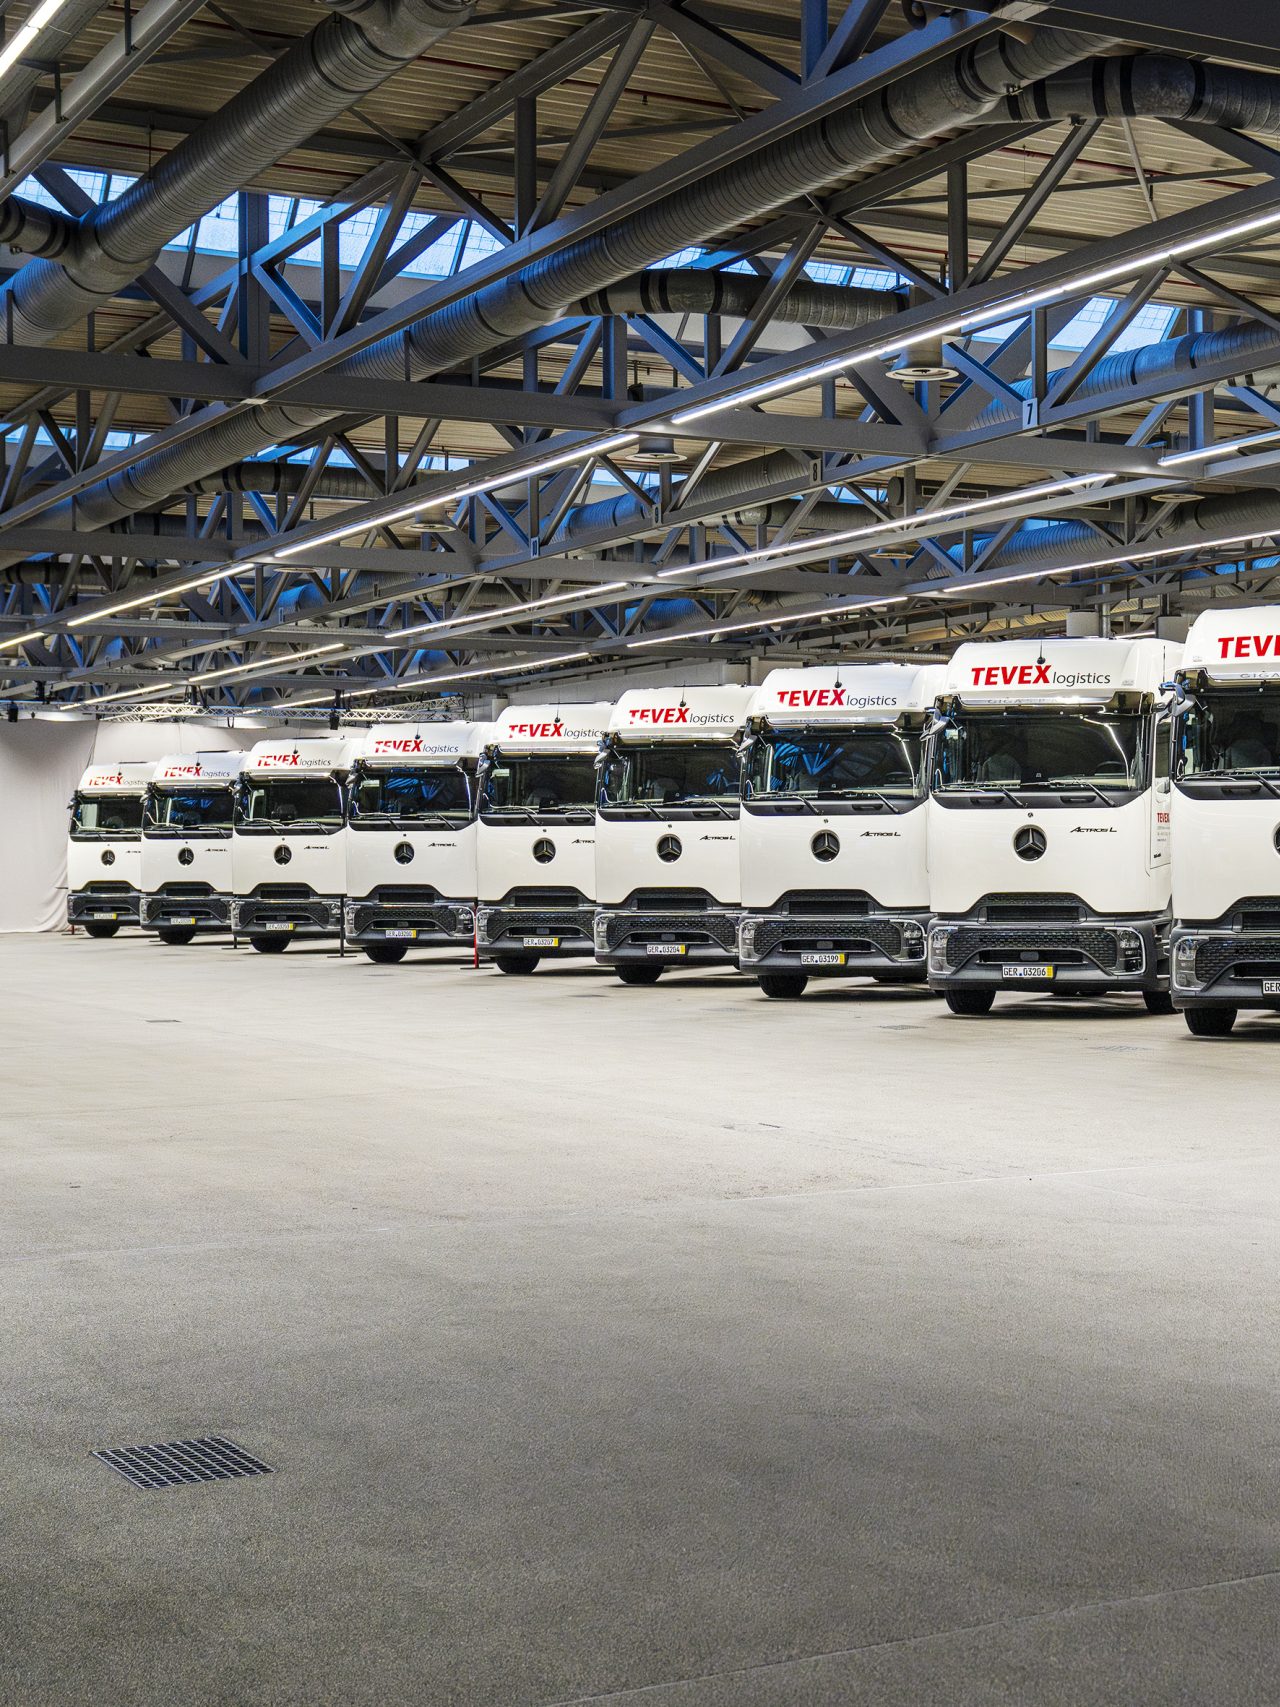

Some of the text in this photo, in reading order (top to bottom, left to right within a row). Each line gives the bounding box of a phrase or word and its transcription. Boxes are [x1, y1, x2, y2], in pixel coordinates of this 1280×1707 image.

[1027, 402, 1033, 425] 7
[813, 462, 818, 482] 8
[971, 665, 1111, 687] TEVEX logistics
[777, 689, 897, 708] TEVEX logistics
[629, 708, 735, 726] TEVEX logistics
[509, 723, 563, 738] TEVEX
[375, 740, 459, 755] TEVEX logistics
